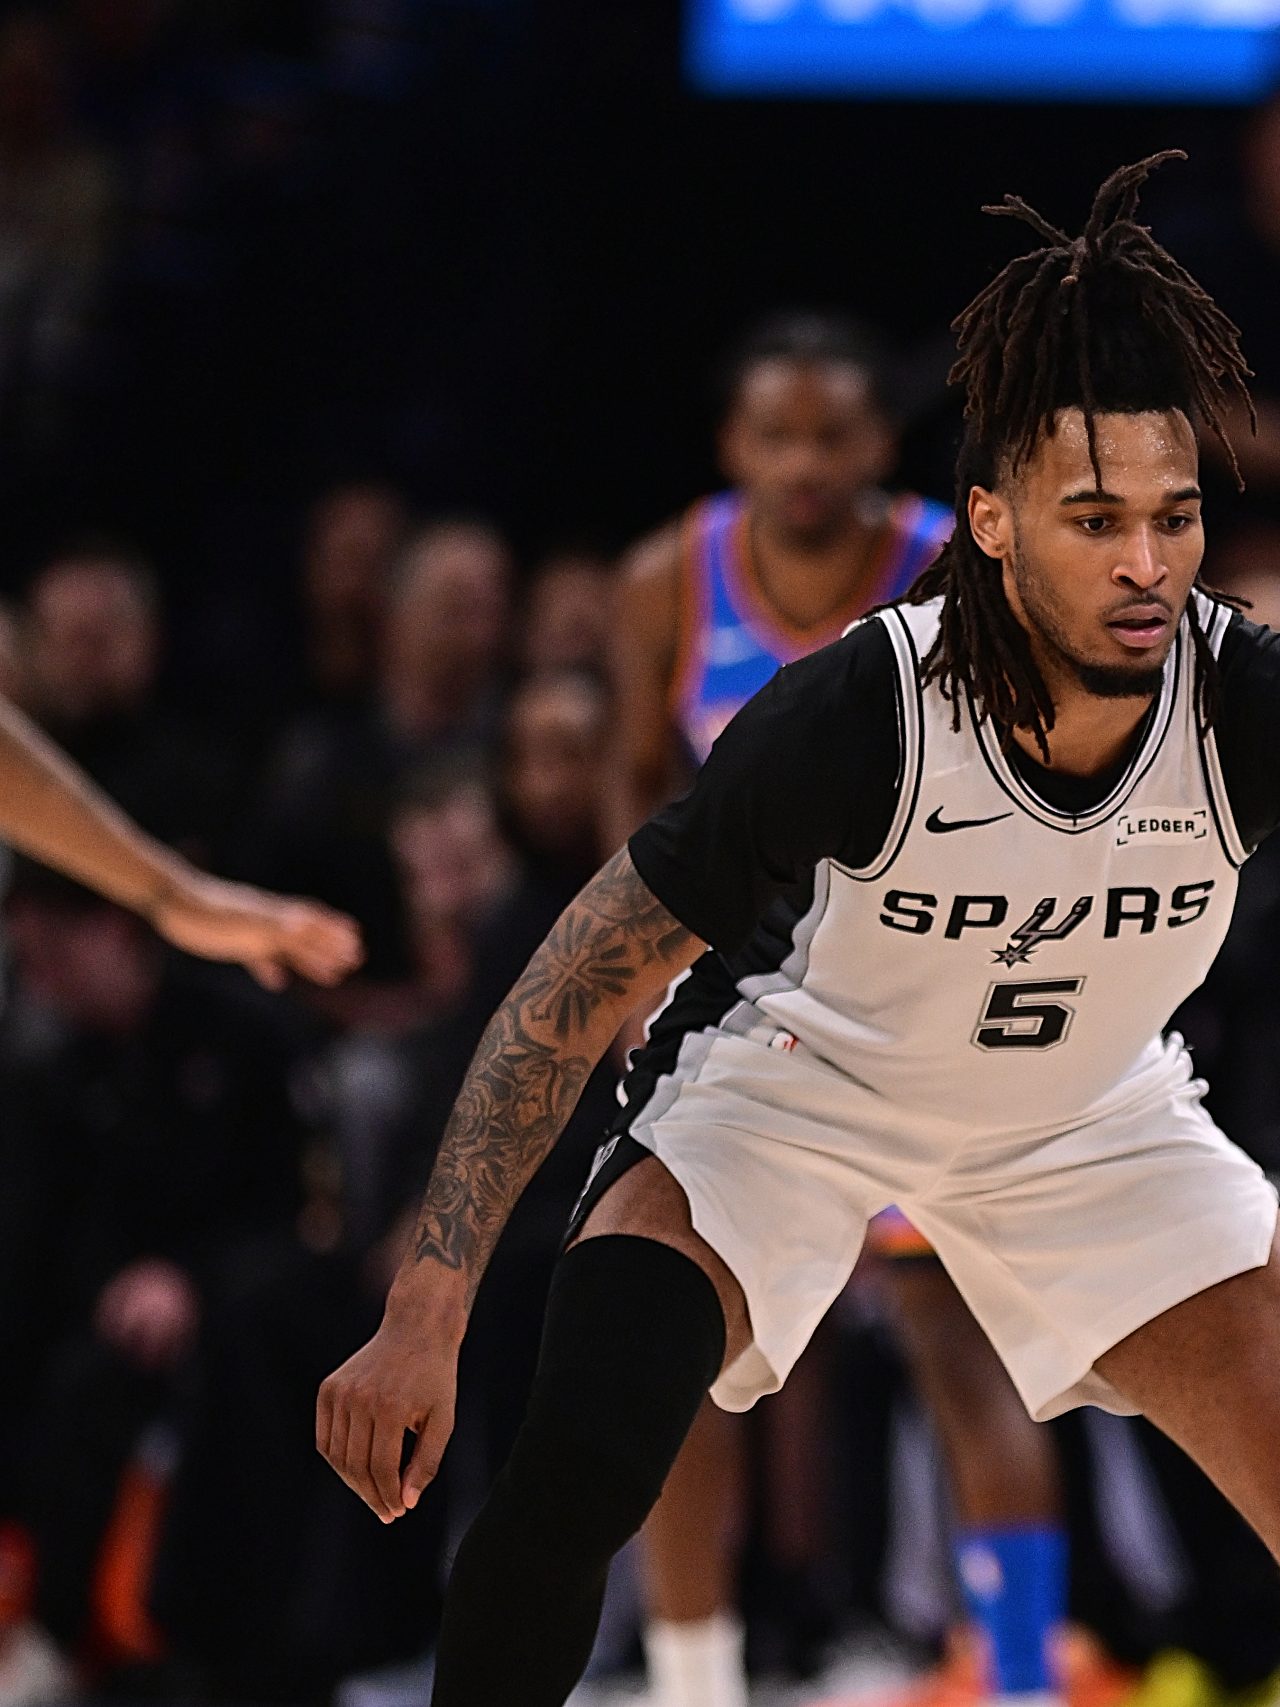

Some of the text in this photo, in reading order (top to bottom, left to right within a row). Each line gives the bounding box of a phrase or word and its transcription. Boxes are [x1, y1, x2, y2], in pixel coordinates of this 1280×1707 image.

[1127, 819, 1195, 836] LEDGER
[879, 879, 1215, 968] SPURS
[970, 976, 1087, 1053] 5
